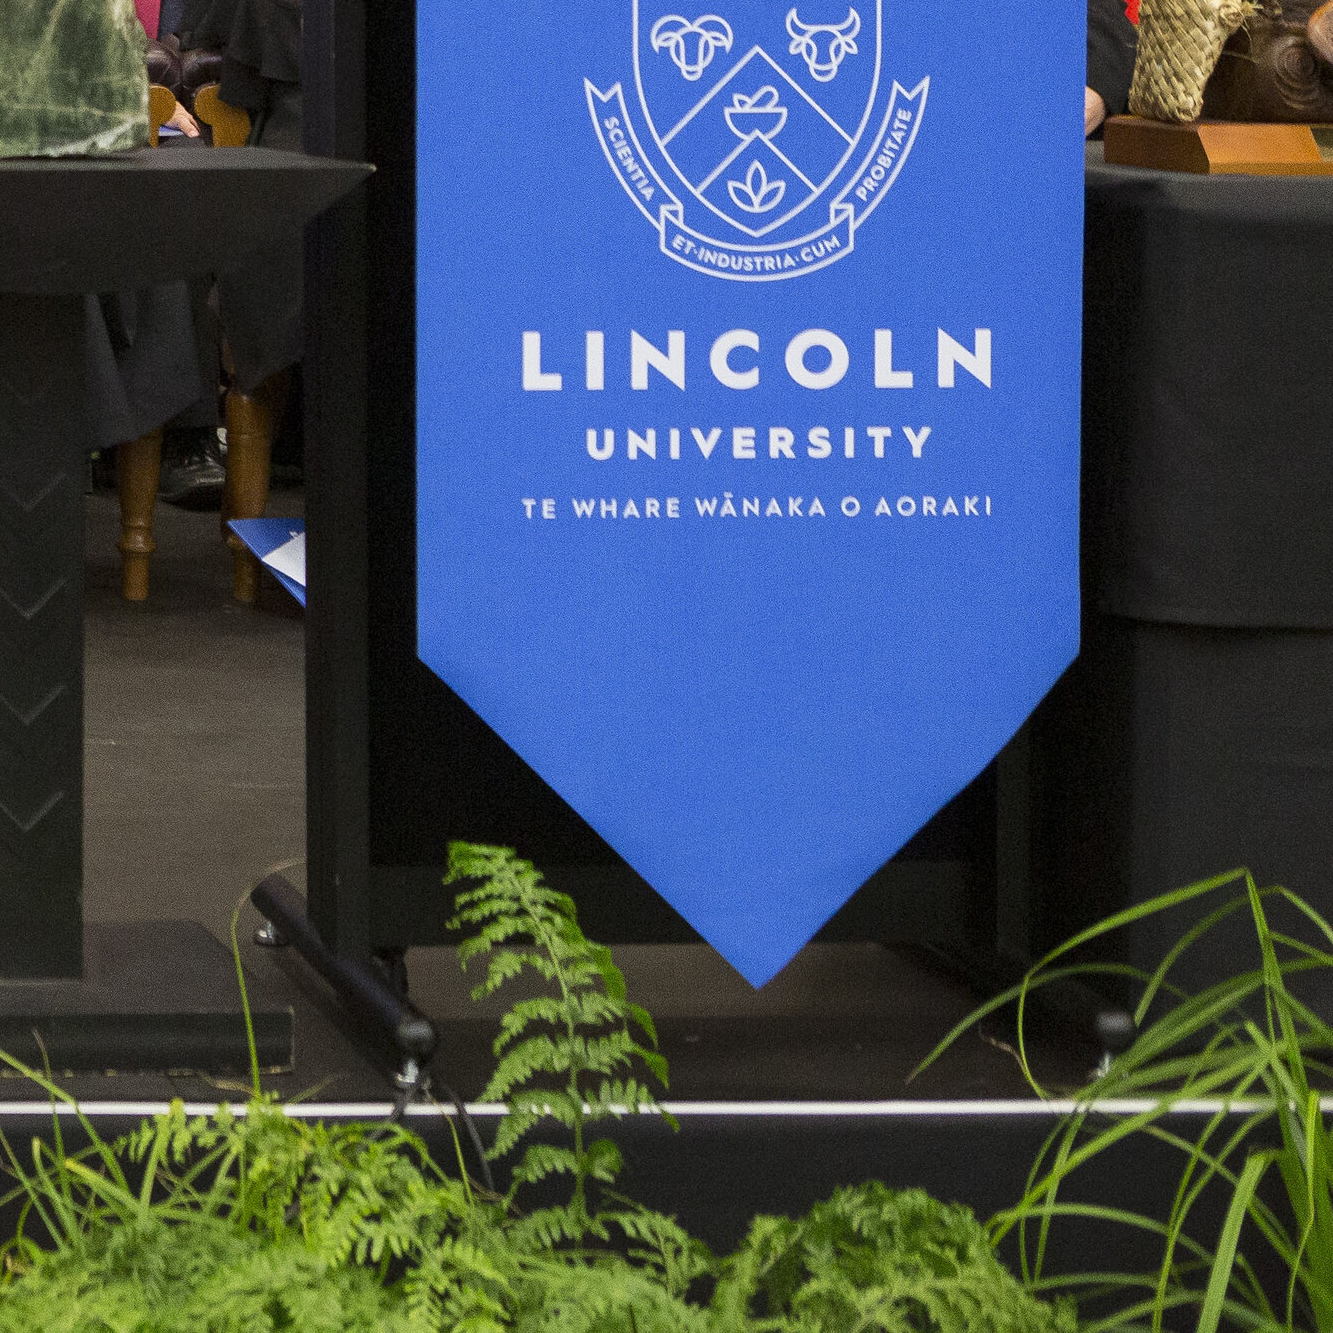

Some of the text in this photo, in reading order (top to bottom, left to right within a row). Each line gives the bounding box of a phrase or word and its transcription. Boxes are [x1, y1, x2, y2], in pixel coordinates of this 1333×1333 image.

[604, 116, 655, 202] SCIENTIA
[855, 107, 913, 202] PROBITATE
[522, 327, 992, 392] LINCOLN
[585, 425, 933, 461] UNIVERSITY
[521, 497, 557, 519] TE
[572, 496, 681, 519] WHARE
[840, 496, 861, 517] O
[874, 496, 992, 517] AORAKI
